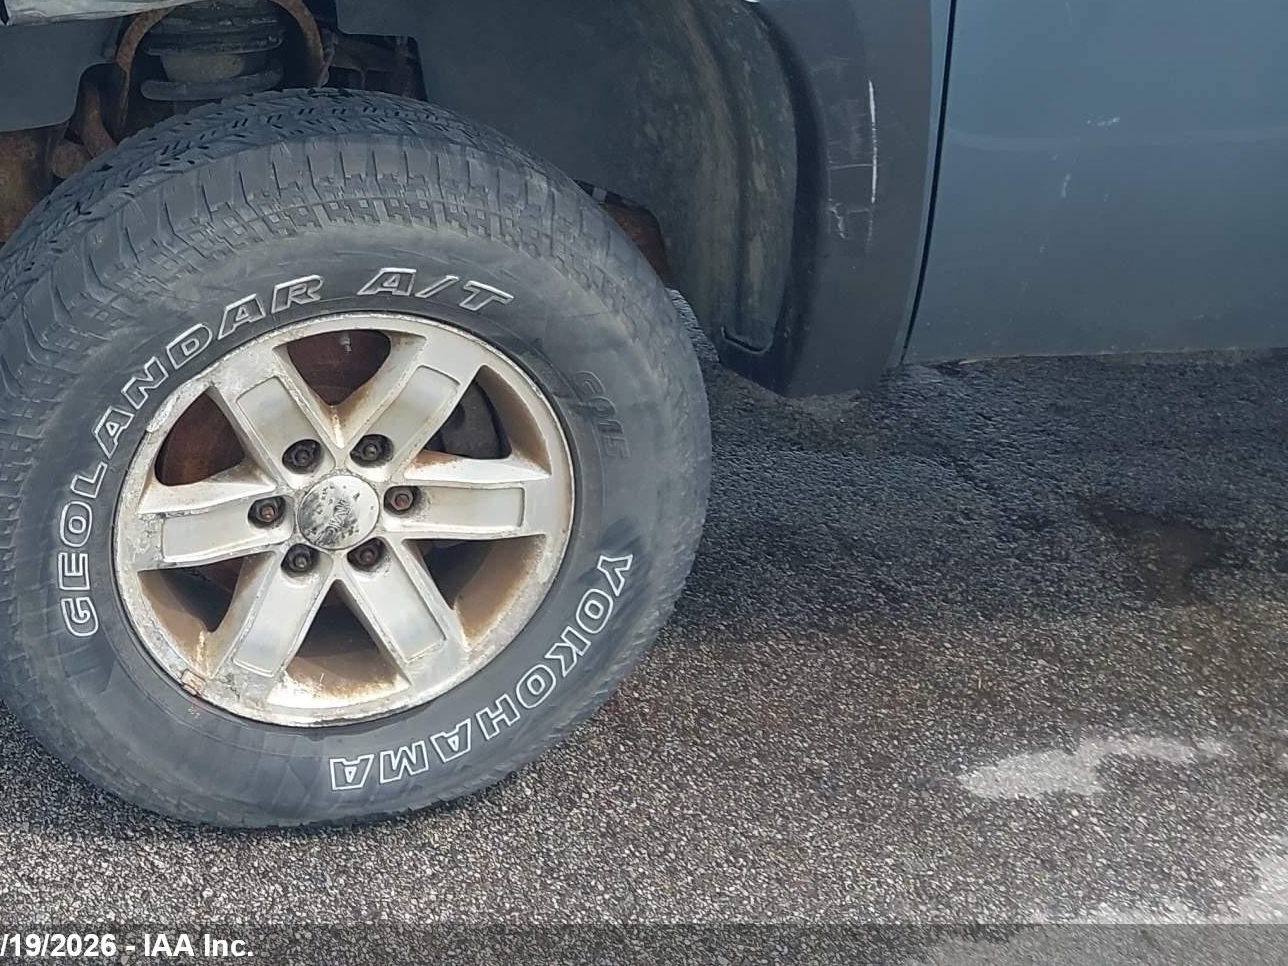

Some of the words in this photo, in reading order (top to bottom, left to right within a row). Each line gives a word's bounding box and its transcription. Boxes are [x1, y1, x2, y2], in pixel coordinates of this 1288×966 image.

[58, 275, 323, 637] GEOLANDAR
[357, 268, 514, 311] A/T
[329, 554, 633, 791] YOKOHAMA
